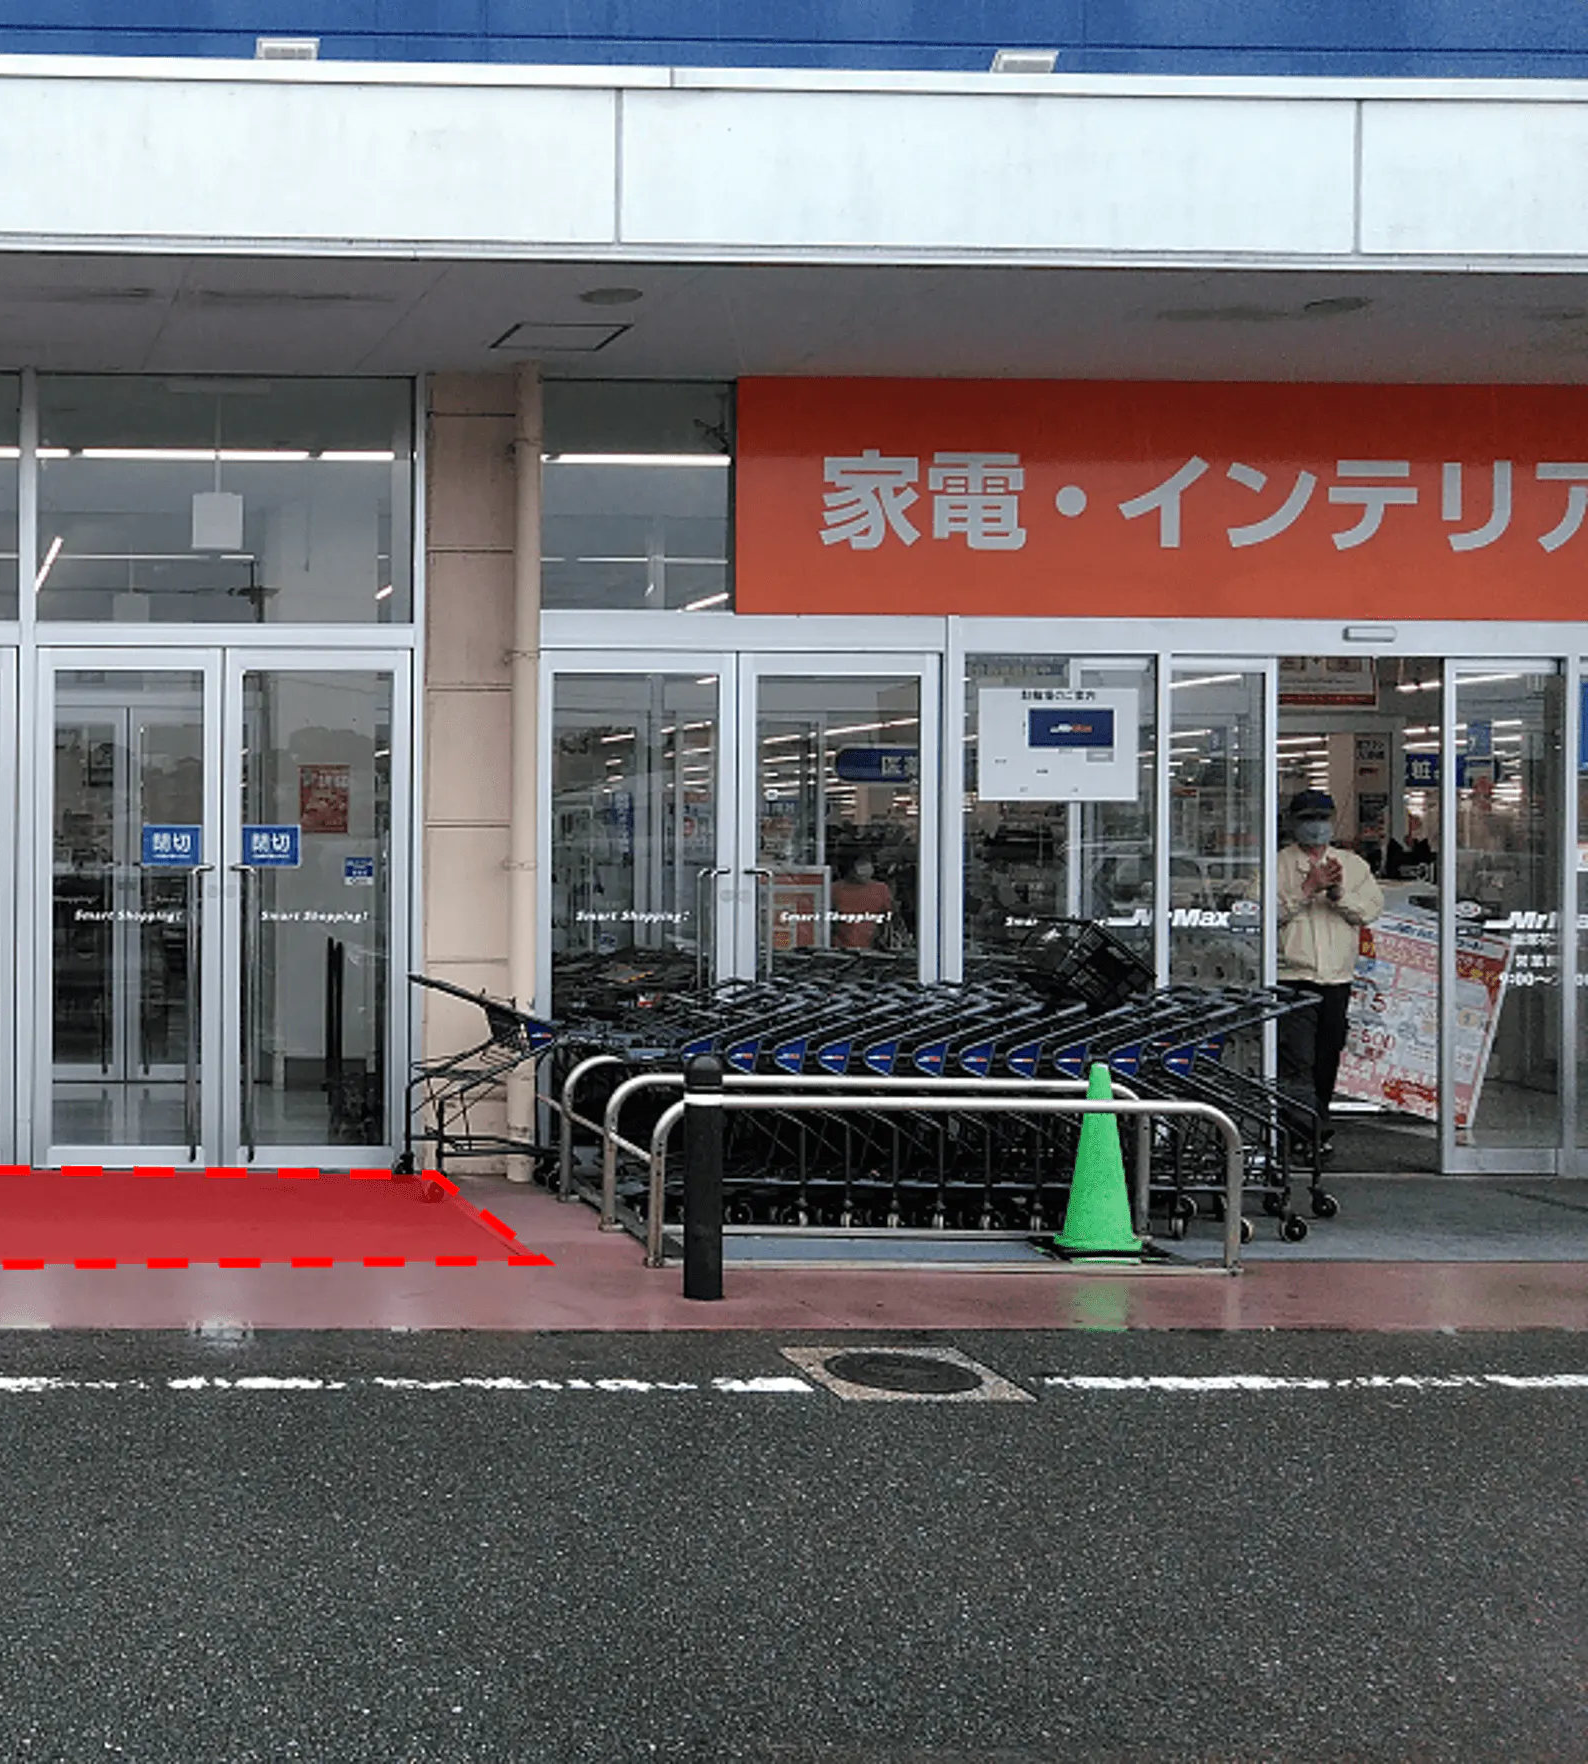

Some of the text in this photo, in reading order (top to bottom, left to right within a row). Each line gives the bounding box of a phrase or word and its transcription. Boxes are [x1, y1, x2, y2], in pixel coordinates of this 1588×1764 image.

[819, 449, 1588, 553] 家電・インテリア
[75, 909, 114, 920] Smart
[261, 910, 300, 920] Smart
[576, 911, 618, 921] Smart
[780, 911, 820, 921] Smart
[1132, 908, 1230, 926] MMax
